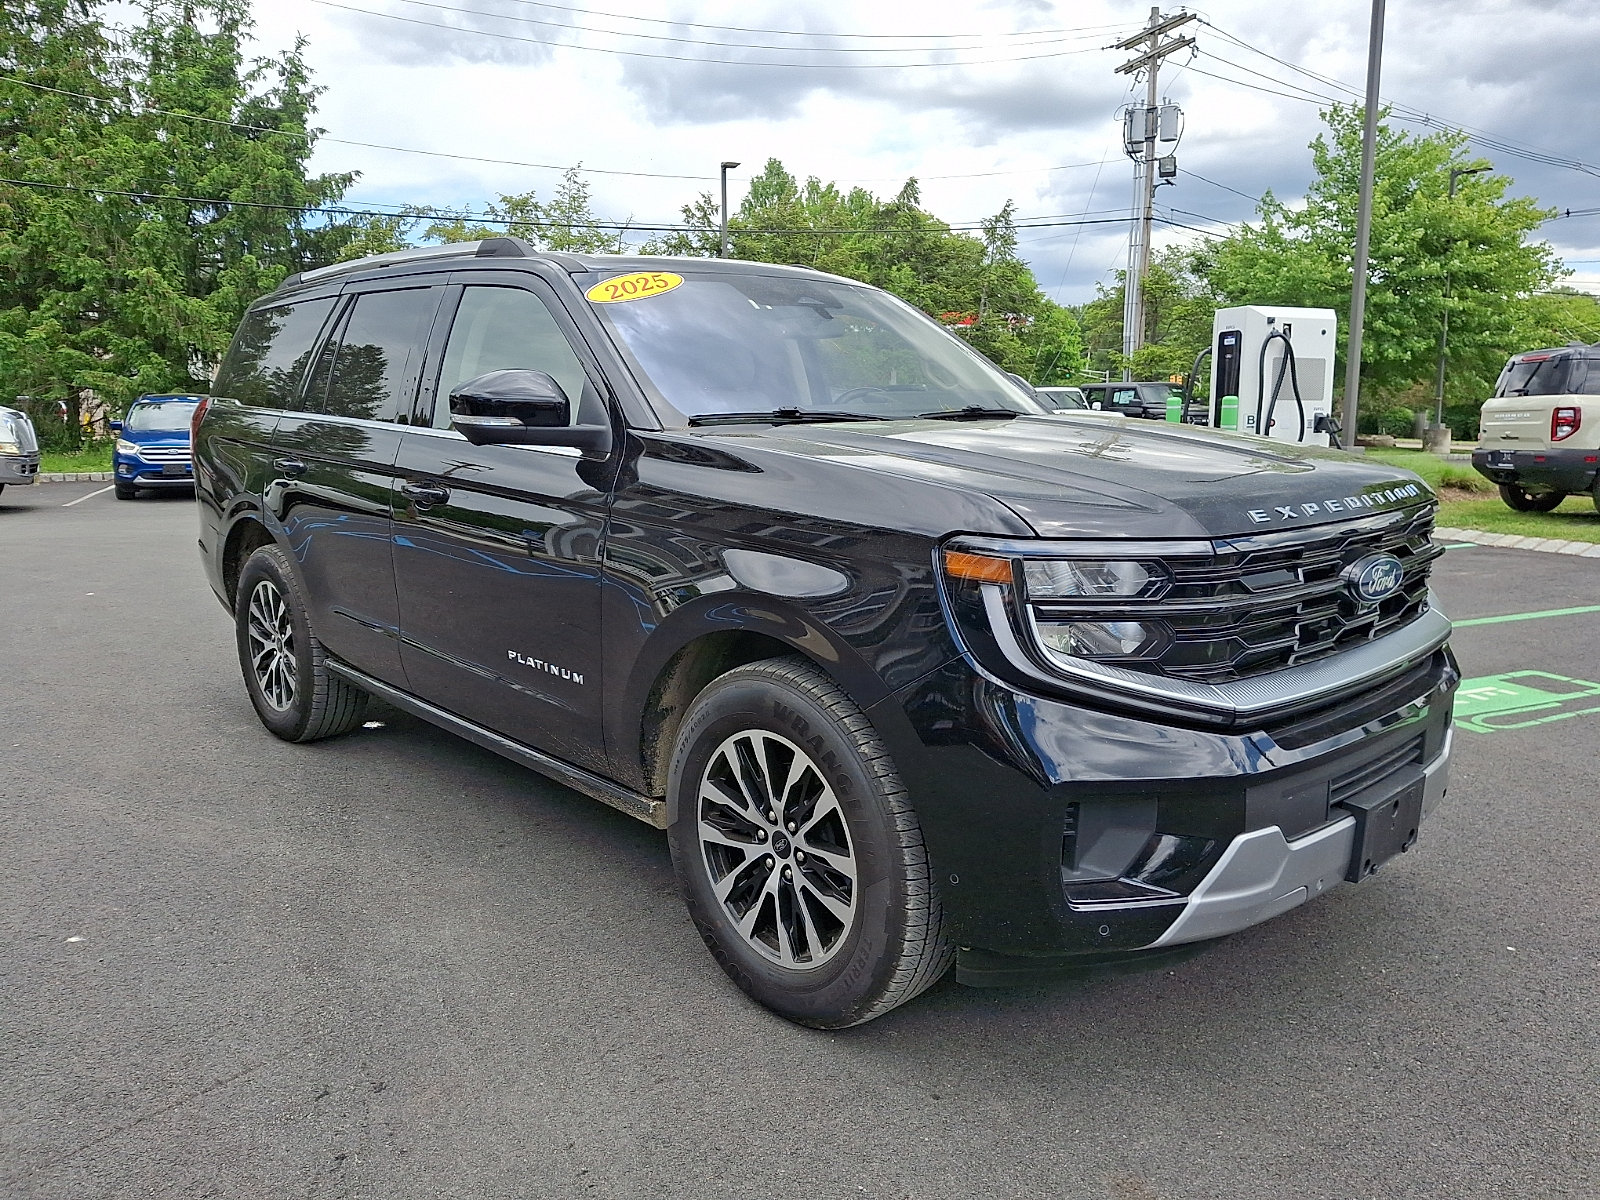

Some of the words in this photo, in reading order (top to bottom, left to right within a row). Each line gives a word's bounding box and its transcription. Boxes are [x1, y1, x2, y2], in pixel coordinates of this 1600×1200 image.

[605, 274, 669, 300] 2025
[1246, 483, 1420, 525] EXPEDITION
[1368, 564, 1397, 594] Ford
[507, 649, 585, 685] PLATINUM
